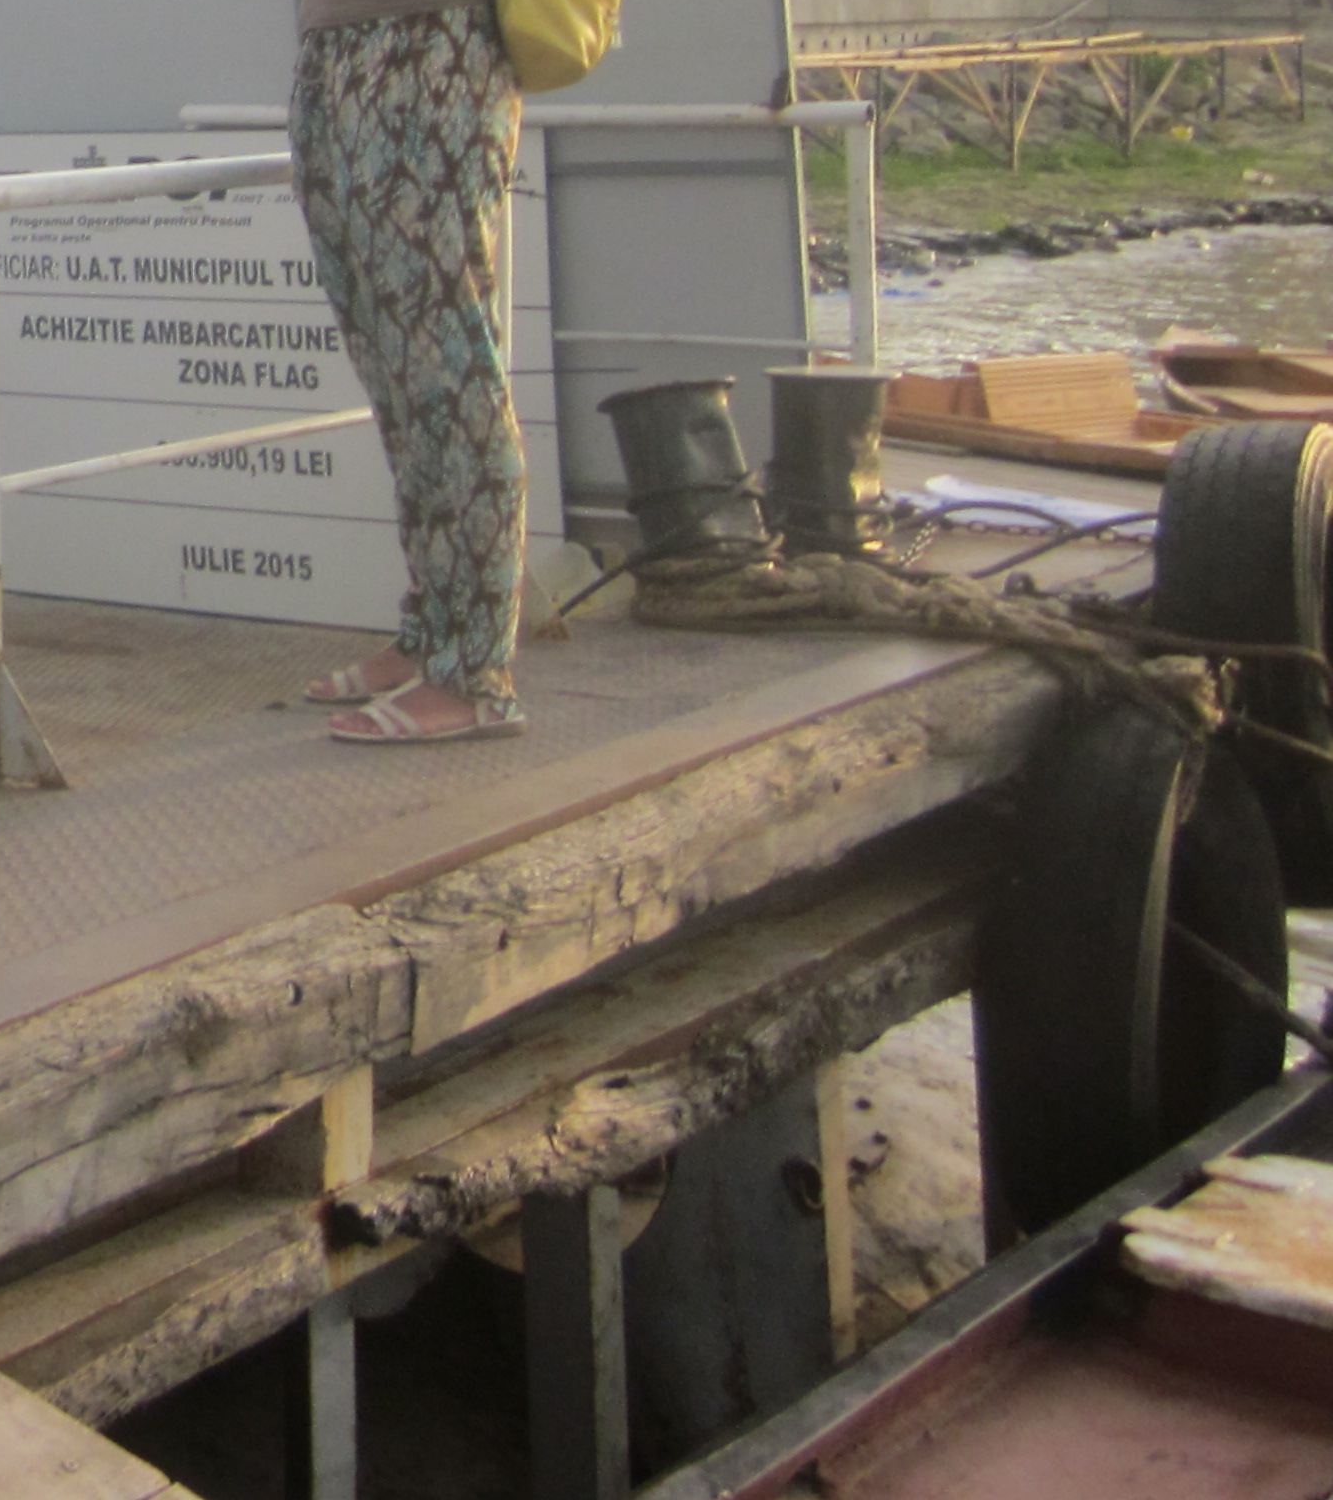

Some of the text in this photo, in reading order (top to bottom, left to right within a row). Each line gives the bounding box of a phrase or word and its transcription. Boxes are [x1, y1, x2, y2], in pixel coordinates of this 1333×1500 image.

[66, 254, 126, 283] U.A.T.
[134, 257, 274, 287] MUNICIPIUL
[21, 314, 340, 352] ACHIZITIE AMBARCATIUNE
[178, 358, 320, 391] ZONA FLAG
[294, 449, 332, 476] LEI
[183, 544, 313, 581] IULIE 2015
